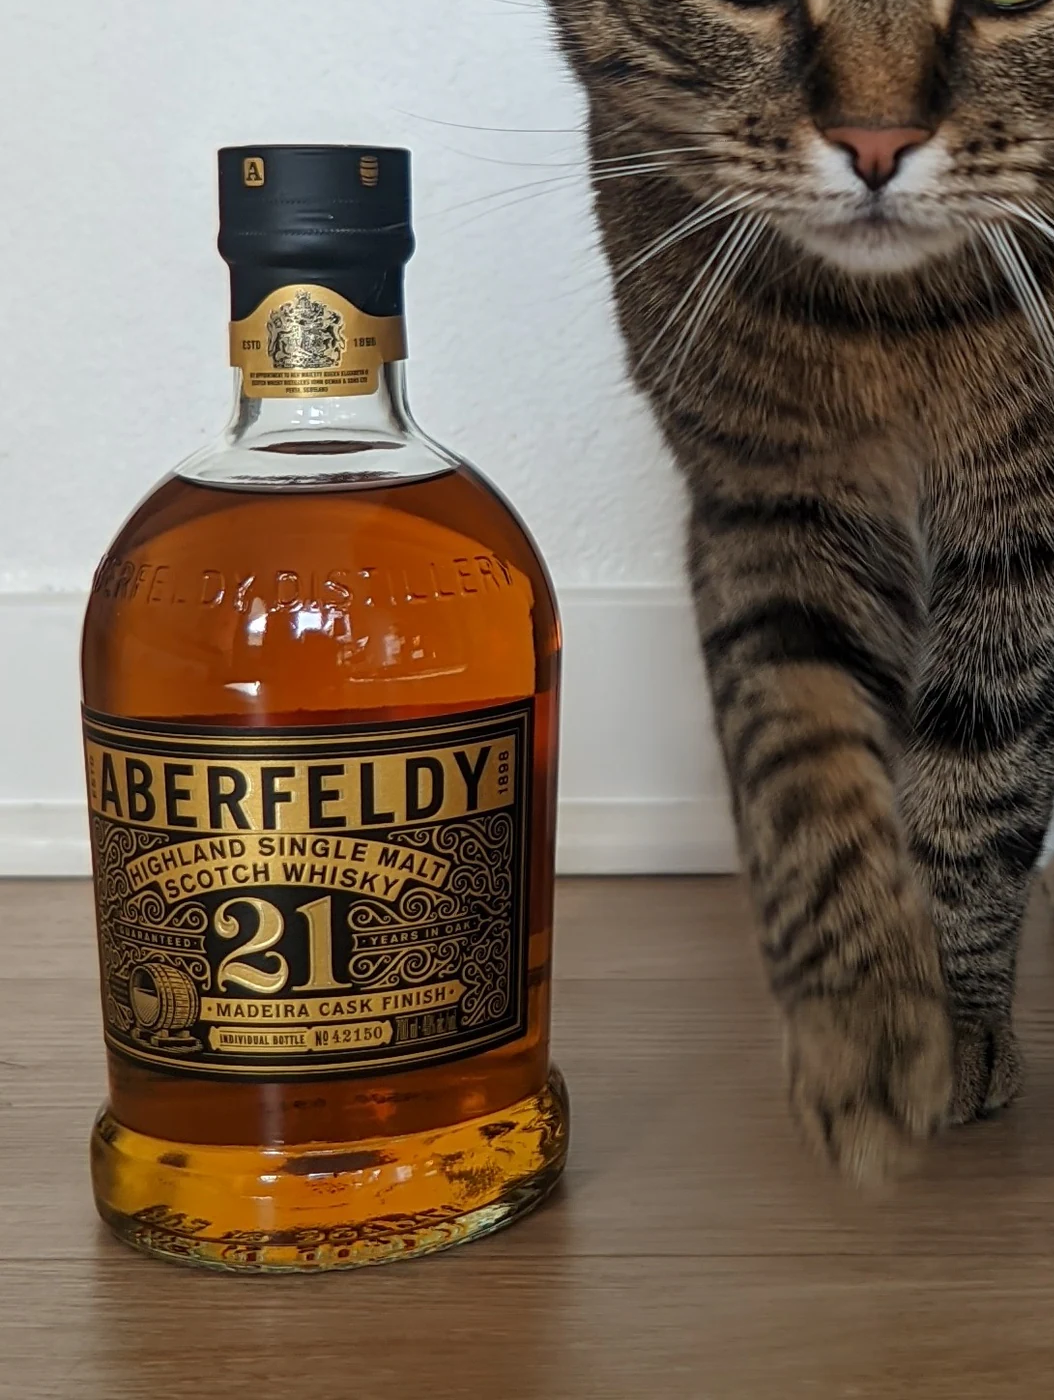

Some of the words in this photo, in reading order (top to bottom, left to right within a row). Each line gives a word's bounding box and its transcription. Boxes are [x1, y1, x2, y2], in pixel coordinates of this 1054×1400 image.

[246, 162, 262, 180] A
[276, 554, 513, 610] DISTILLERY
[101, 746, 498, 830] ABERFELDY
[497, 750, 509, 795] 1898
[129, 837, 246, 888] HIGHLAND
[258, 837, 367, 862] SINGLE
[378, 846, 447, 884] MALT
[165, 861, 271, 900] SCOTCH
[283, 862, 400, 897] WHISKY
[120, 926, 191, 947] GUARANTEED
[214, 895, 352, 993] 21
[370, 930, 420, 946] YEARS
[425, 927, 439, 939] IN
[444, 921, 472, 935] OAK
[216, 1002, 310, 1018] MADEIRA
[319, 999, 373, 1015] CASK
[382, 987, 446, 1011] FINISH
[219, 1033, 269, 1045] INDIVIDUAL
[273, 1033, 305, 1045] BOTTLE
[332, 1026, 383, 1043] 42150
